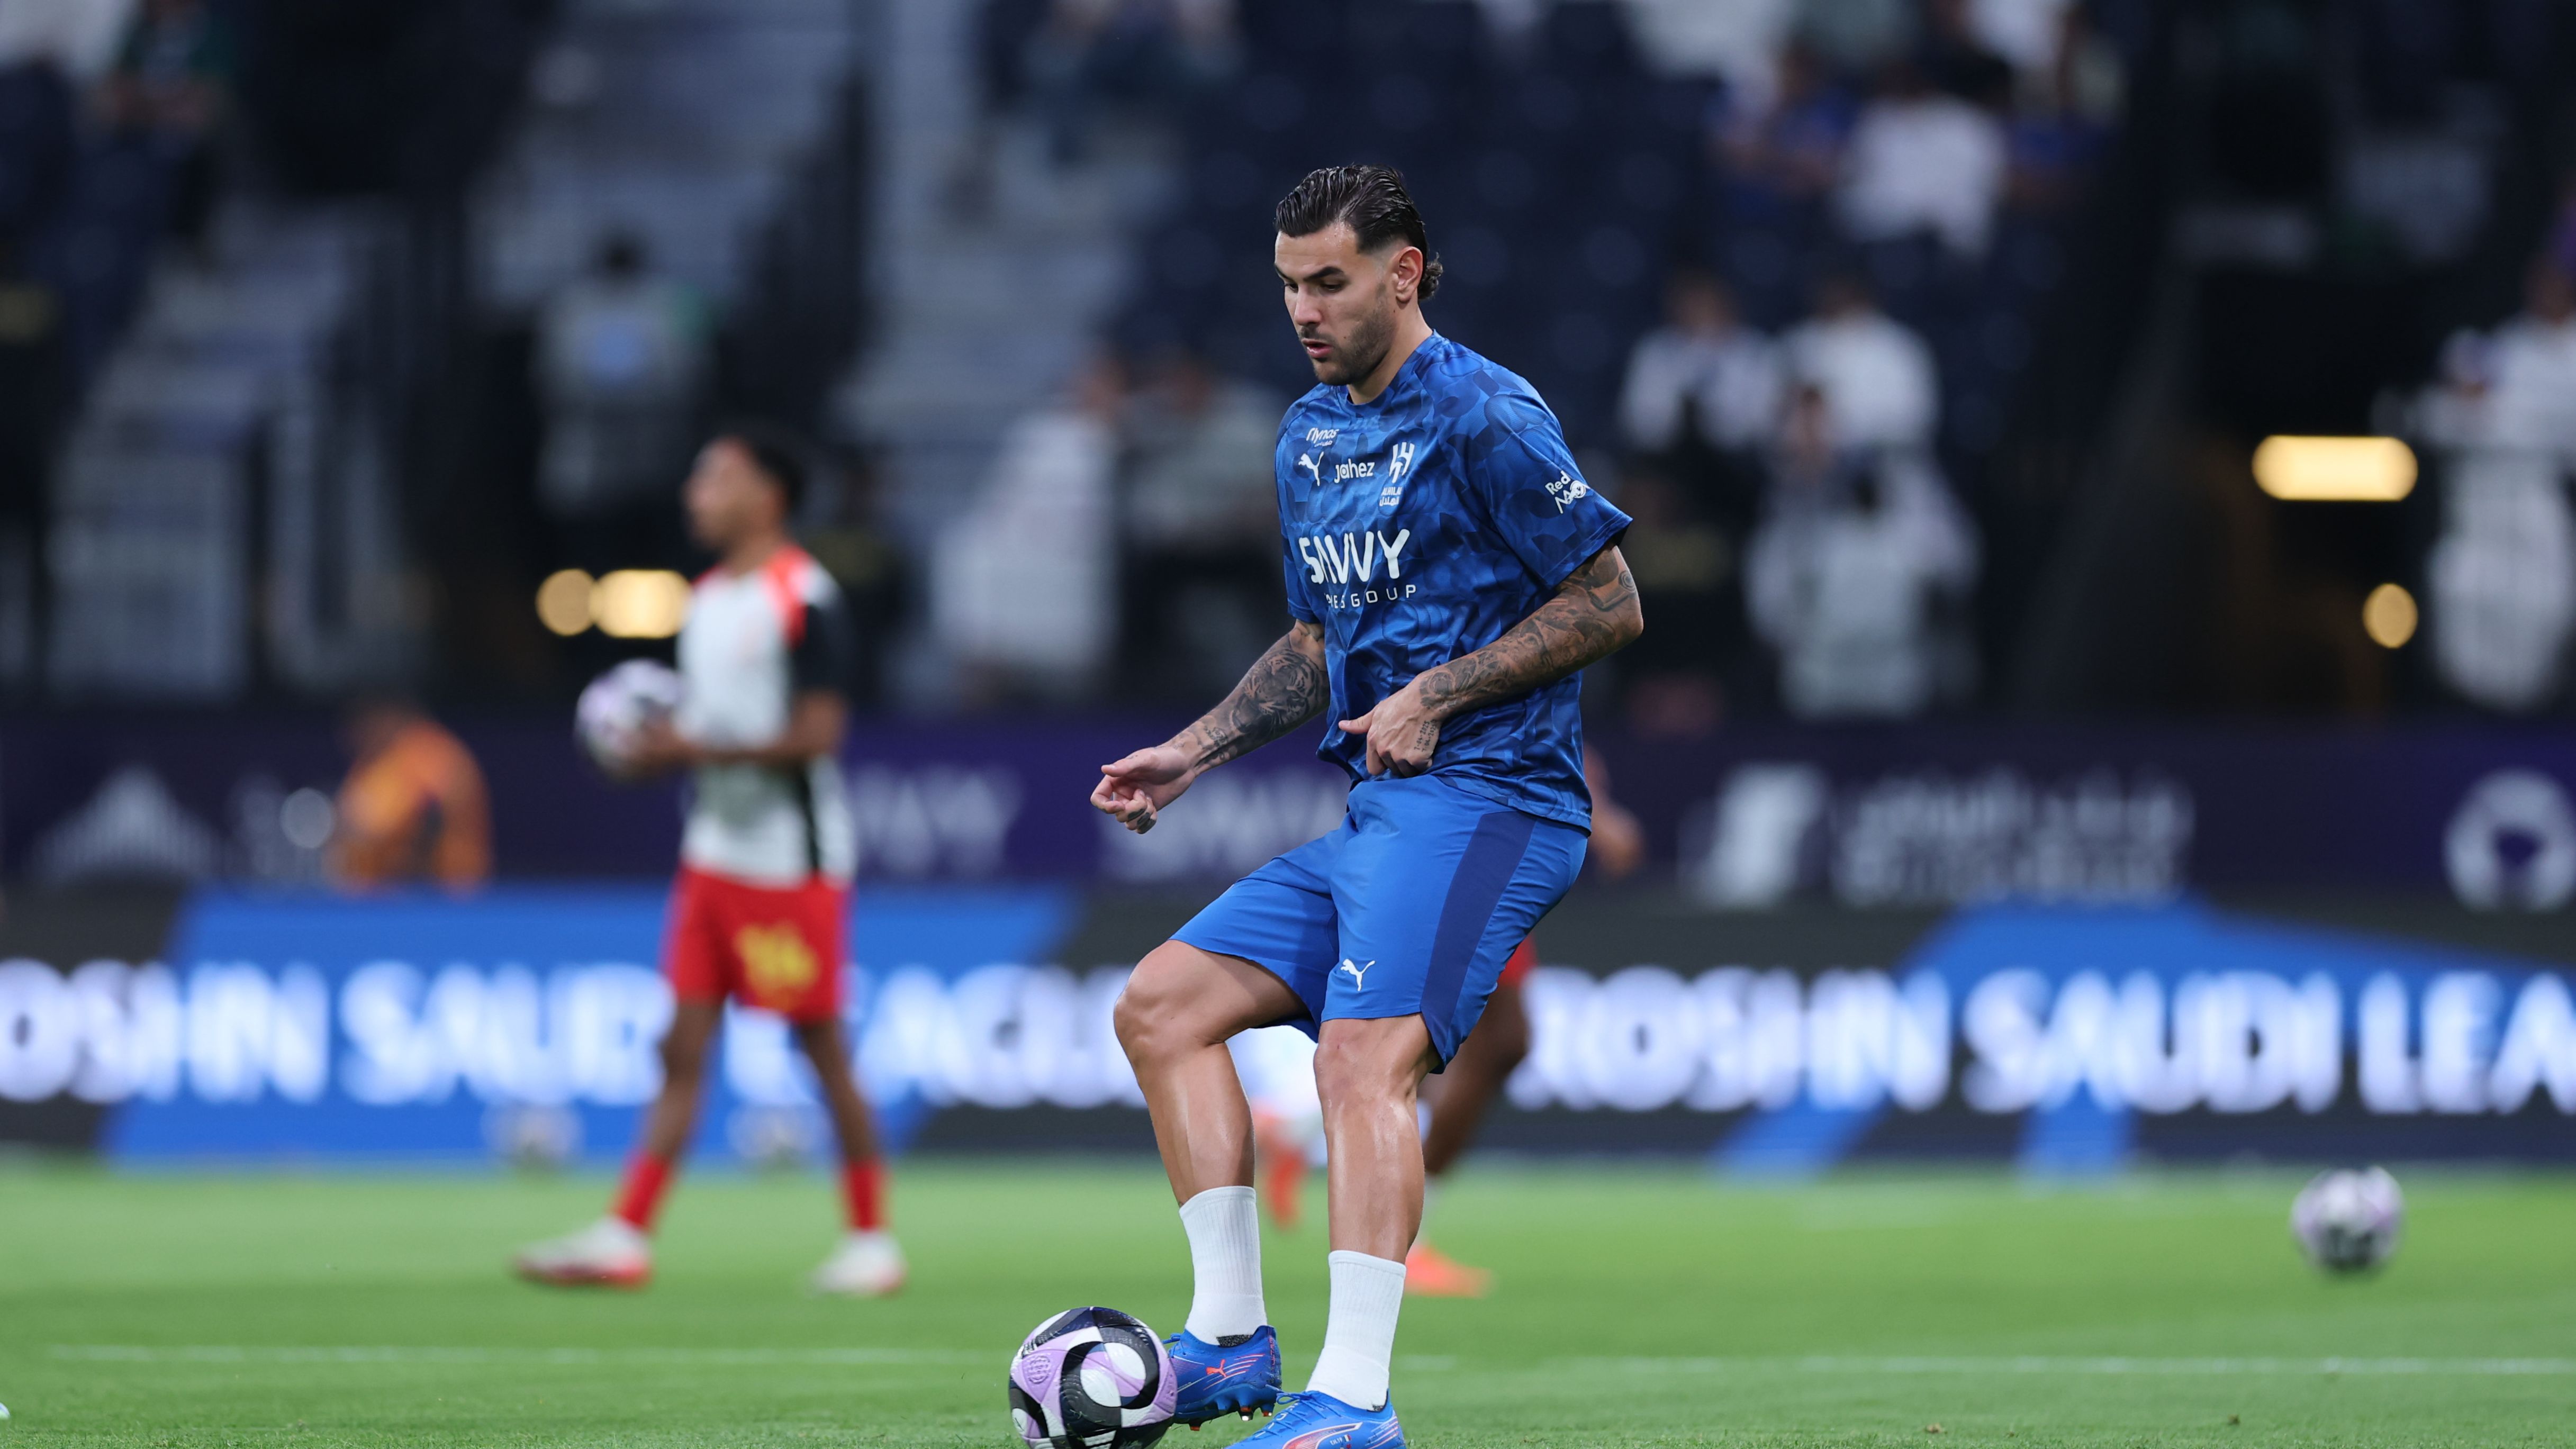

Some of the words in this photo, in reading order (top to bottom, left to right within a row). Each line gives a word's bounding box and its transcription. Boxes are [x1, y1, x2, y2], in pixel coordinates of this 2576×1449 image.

[1334, 458, 1375, 484] jahez
[1545, 470, 1571, 495] Red
[1298, 529, 1411, 584] SAVVY
[1350, 584, 1416, 608] GOUP
[339, 960, 676, 1106] SAUD
[1961, 967, 2344, 1113] SAUDI
